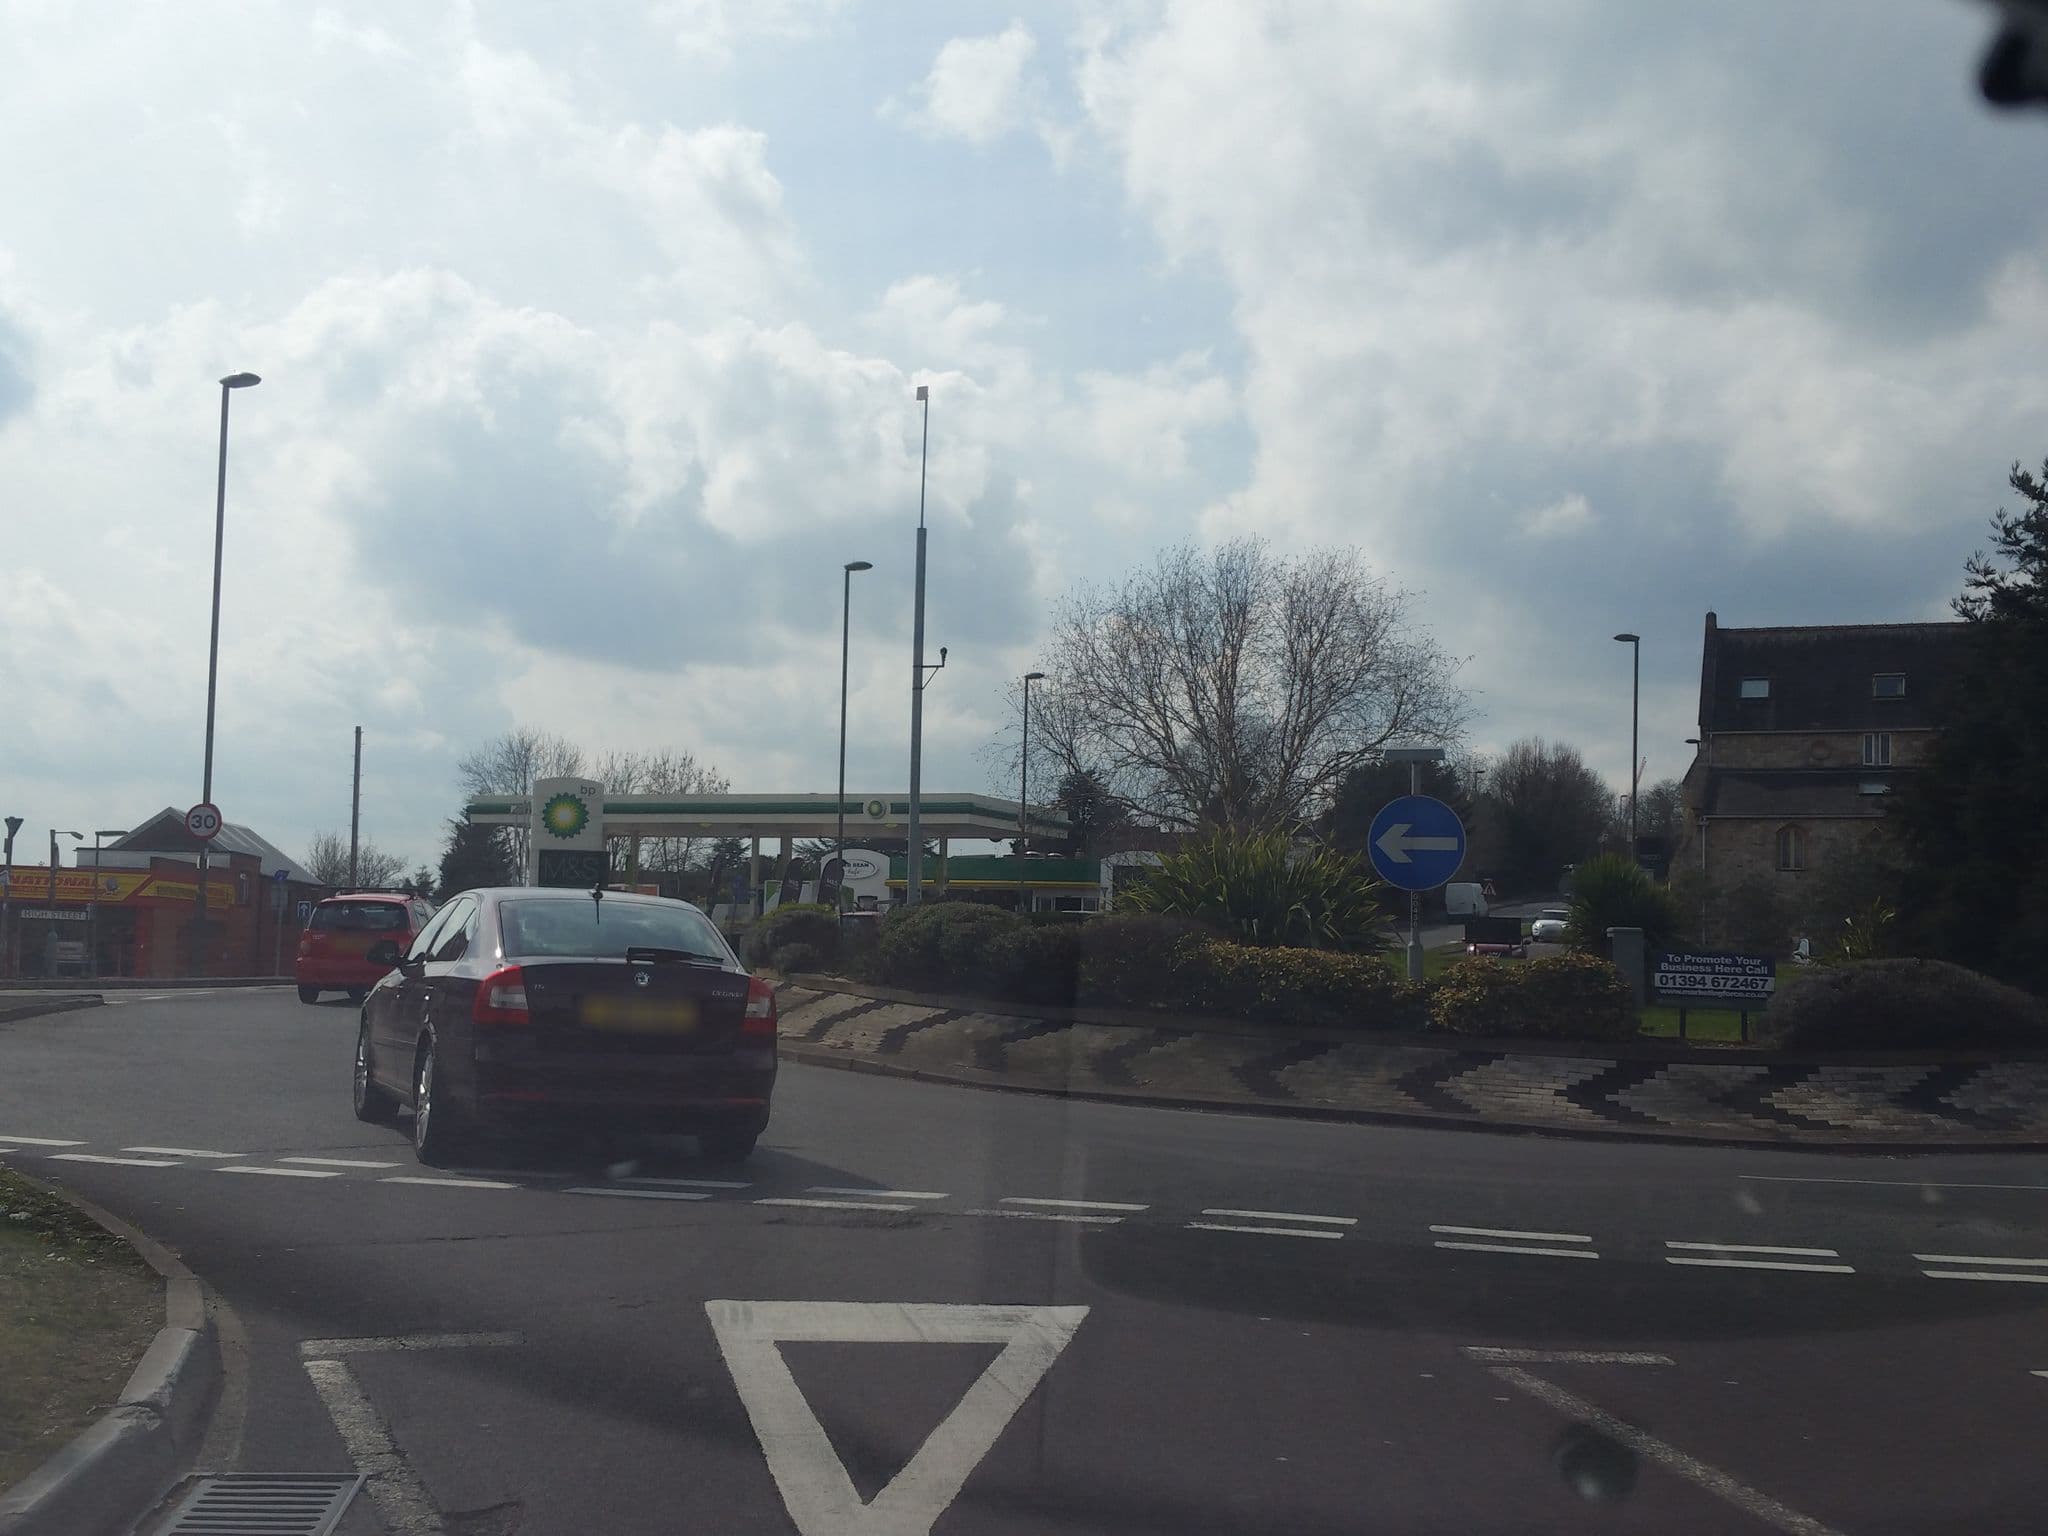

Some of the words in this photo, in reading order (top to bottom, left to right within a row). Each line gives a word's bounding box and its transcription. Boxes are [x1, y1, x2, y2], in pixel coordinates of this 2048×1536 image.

[580, 786, 596, 797] bp
[191, 814, 216, 829] 30
[545, 857, 598, 879] M&S
[1667, 954, 1681, 963] To
[1684, 954, 1732, 964] Promote
[1736, 956, 1761, 966] Your
[1661, 962, 1712, 972] Business
[1715, 965, 1743, 974] Here
[1746, 965, 1768, 975] Call
[1660, 974, 1708, 987] 01394
[1710, 976, 1769, 989] 672467
